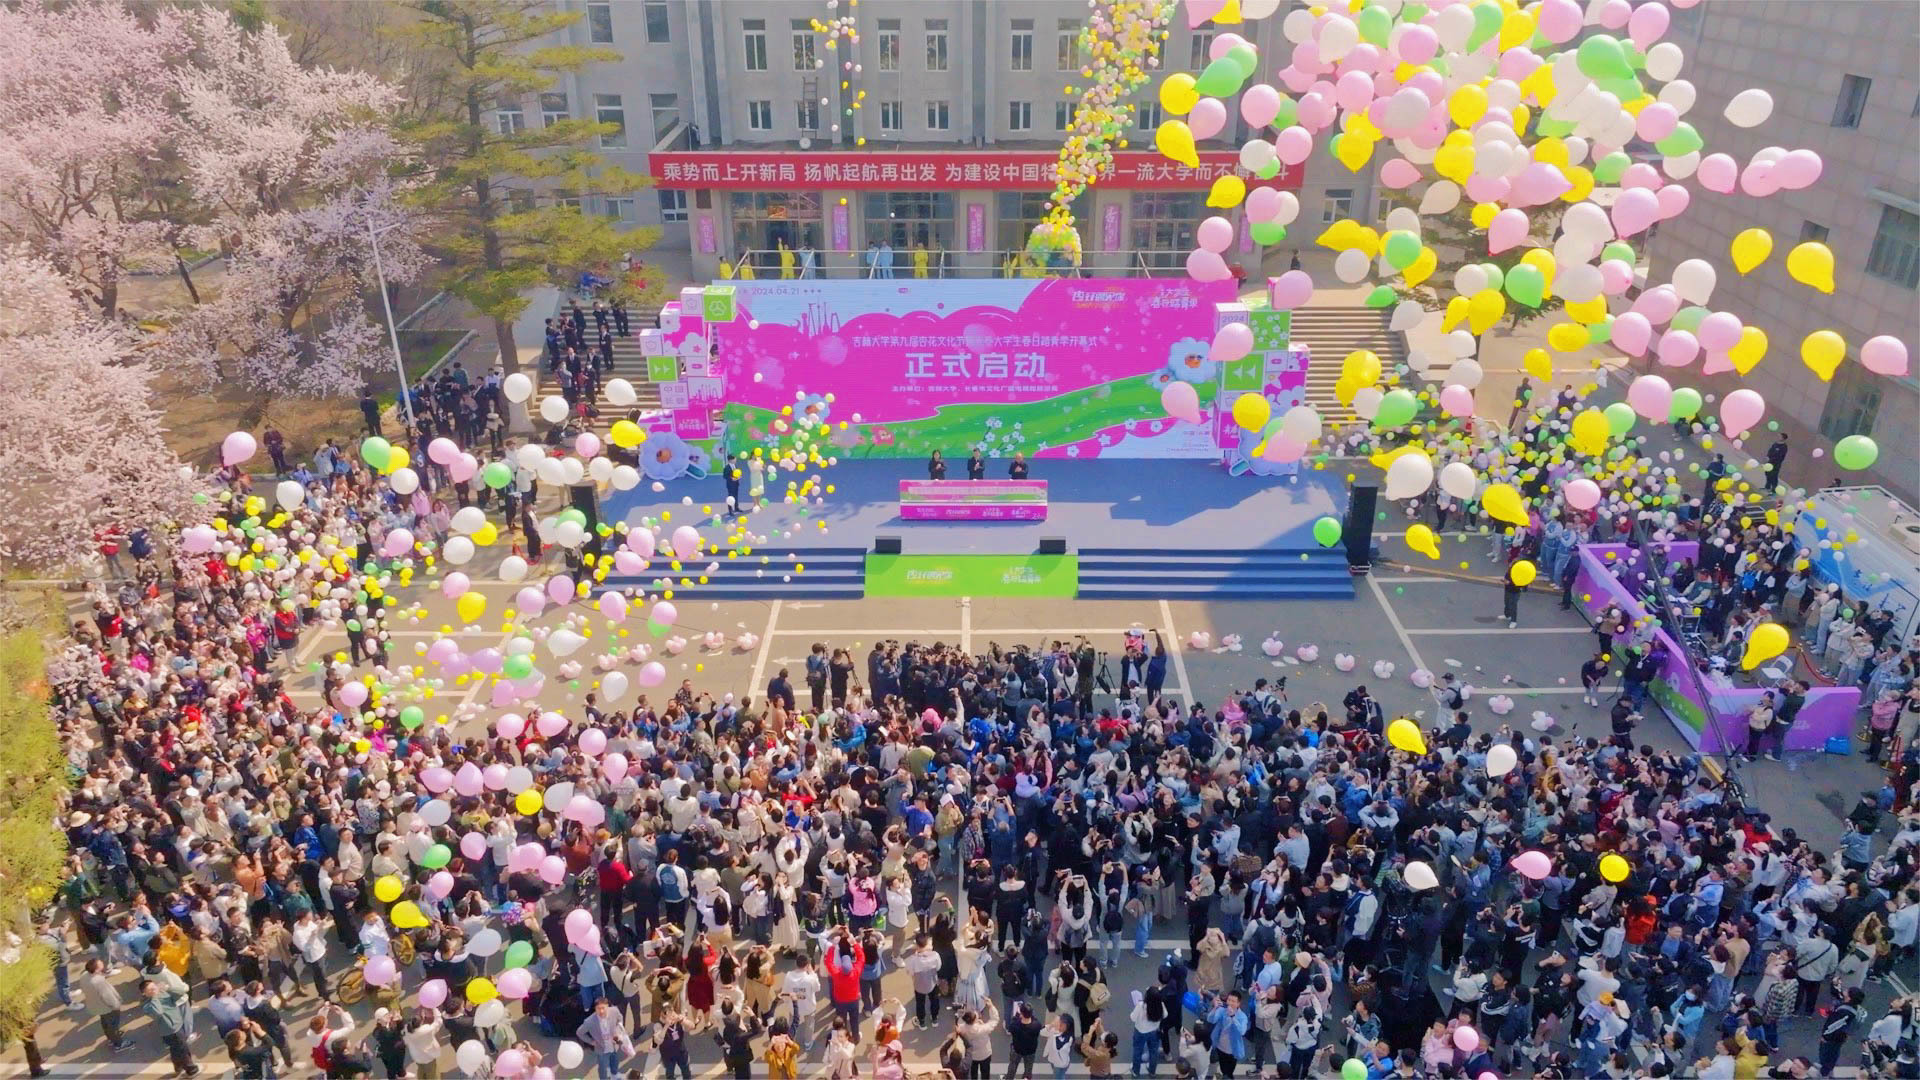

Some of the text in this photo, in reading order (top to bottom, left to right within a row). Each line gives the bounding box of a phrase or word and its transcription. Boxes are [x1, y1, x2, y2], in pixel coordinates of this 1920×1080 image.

[663, 162, 1289, 182] 乘势而上开新局 扬帆起航再出发 为建设中国特界一流大学而不懈斗
[752, 287, 800, 296] 2024.04.21
[852, 335, 1097, 347] 吉林大学第九届杏花文化节大学生春日踏青季开幕式
[905, 352, 1046, 378] 正式启动
